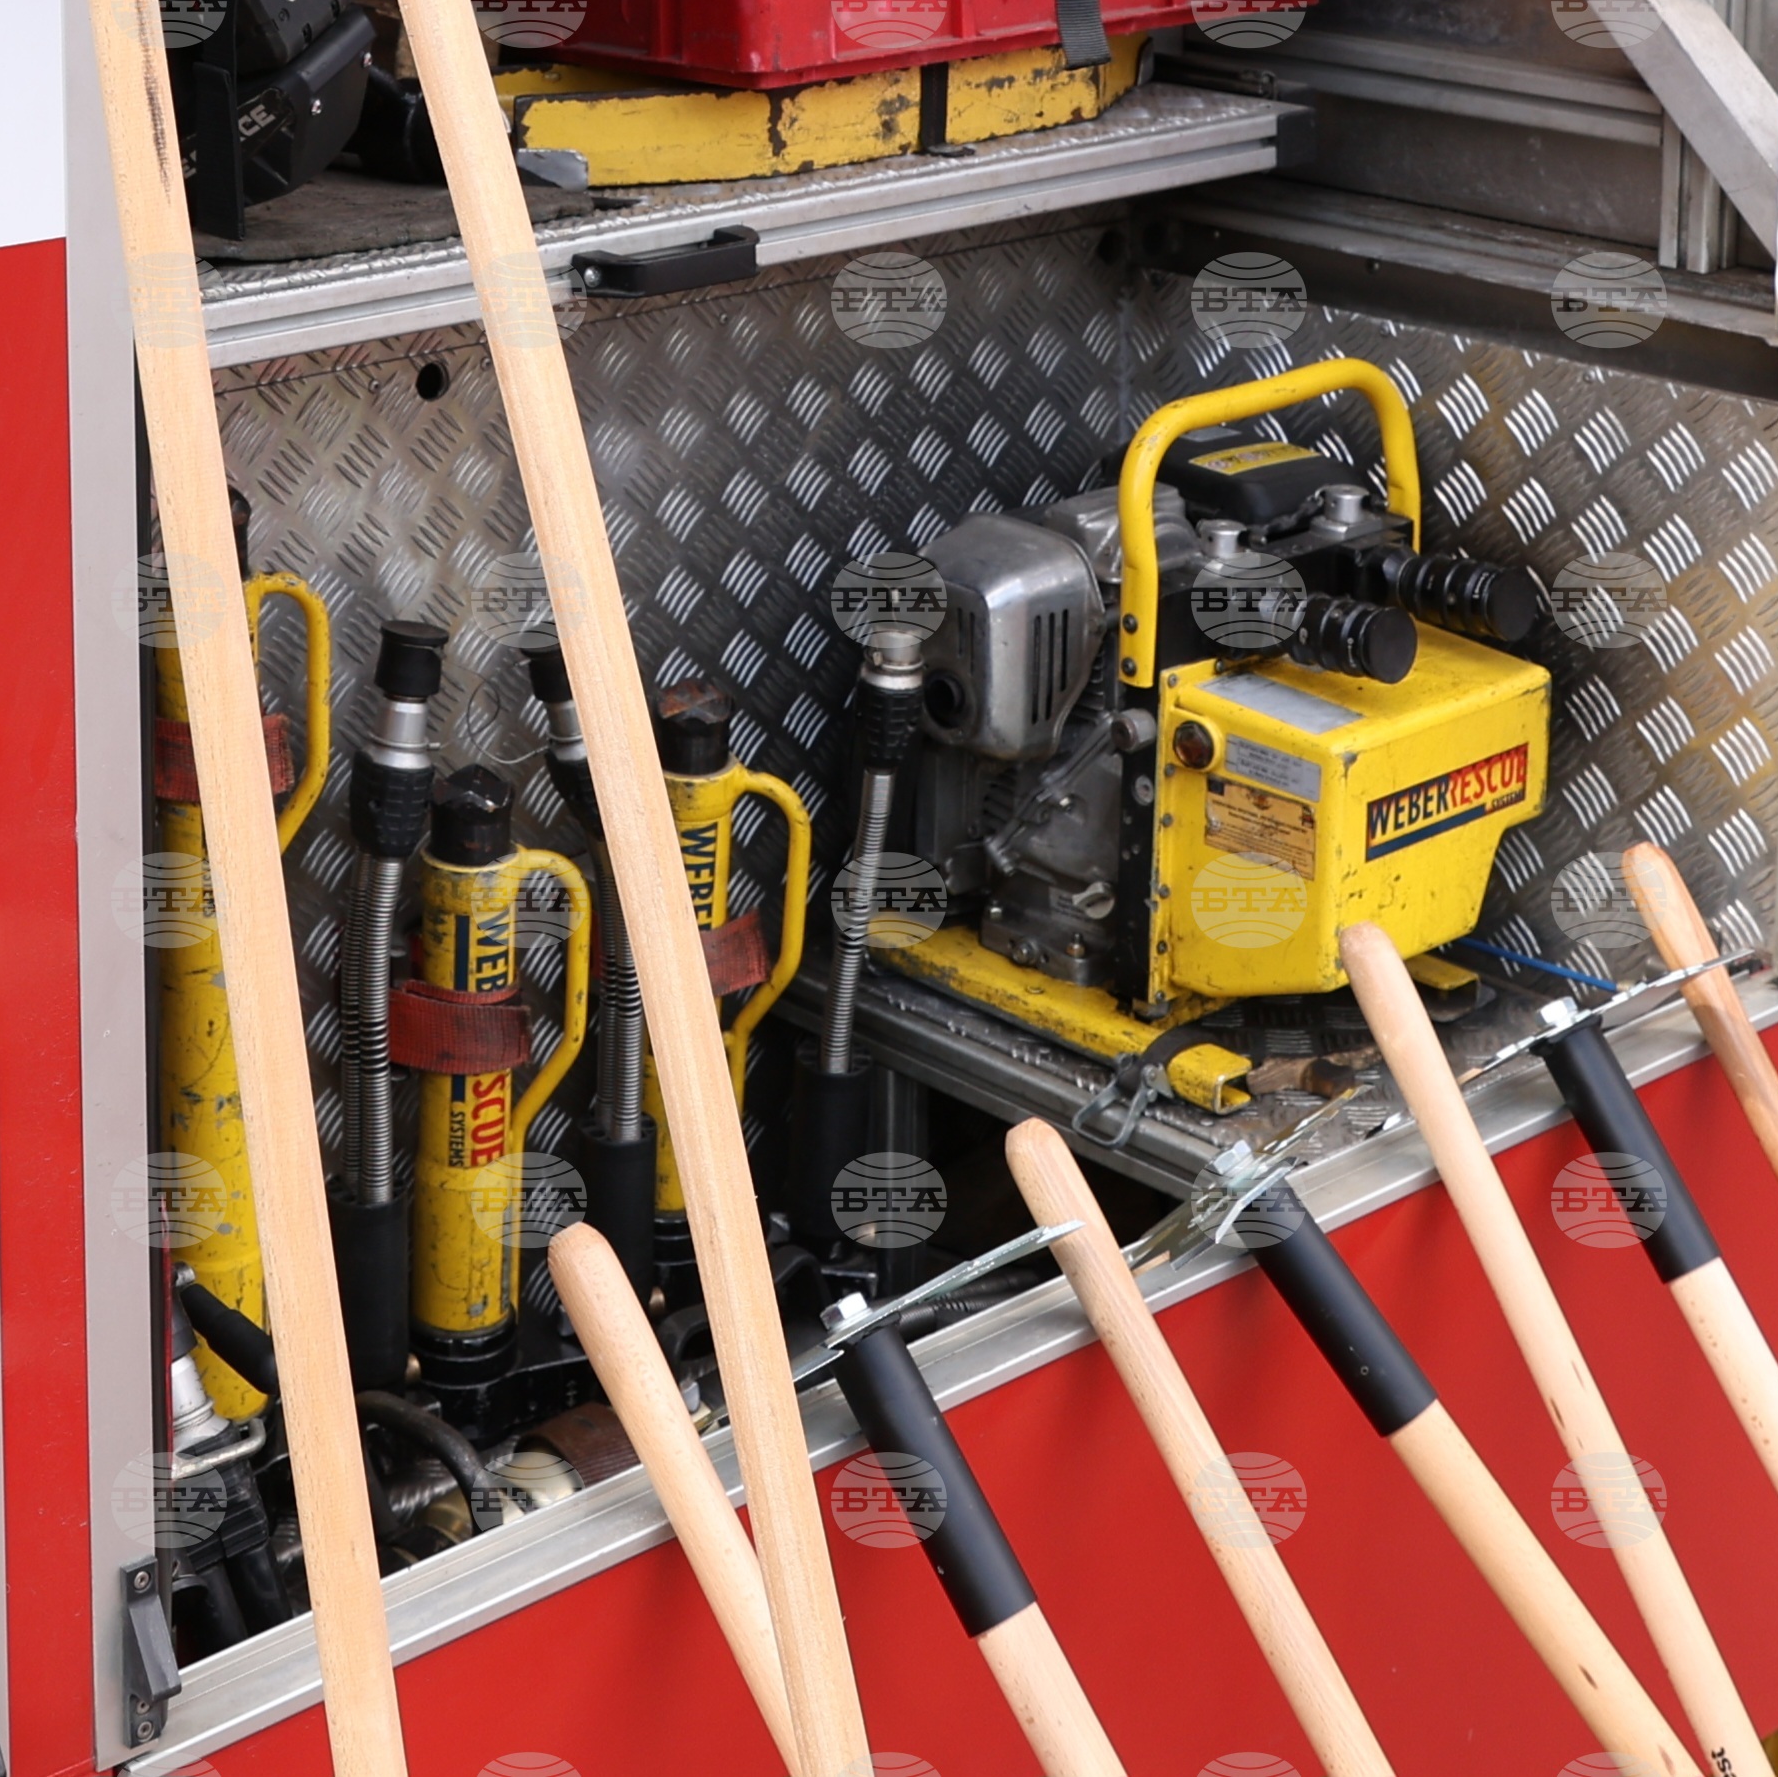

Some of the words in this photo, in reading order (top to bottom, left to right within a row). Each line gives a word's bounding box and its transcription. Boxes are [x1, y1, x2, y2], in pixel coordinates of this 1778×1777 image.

[1369, 774, 1450, 840] WEBER
[1448, 743, 1528, 809] RESCUE
[450, 1110, 466, 1169] SYSTEMS
